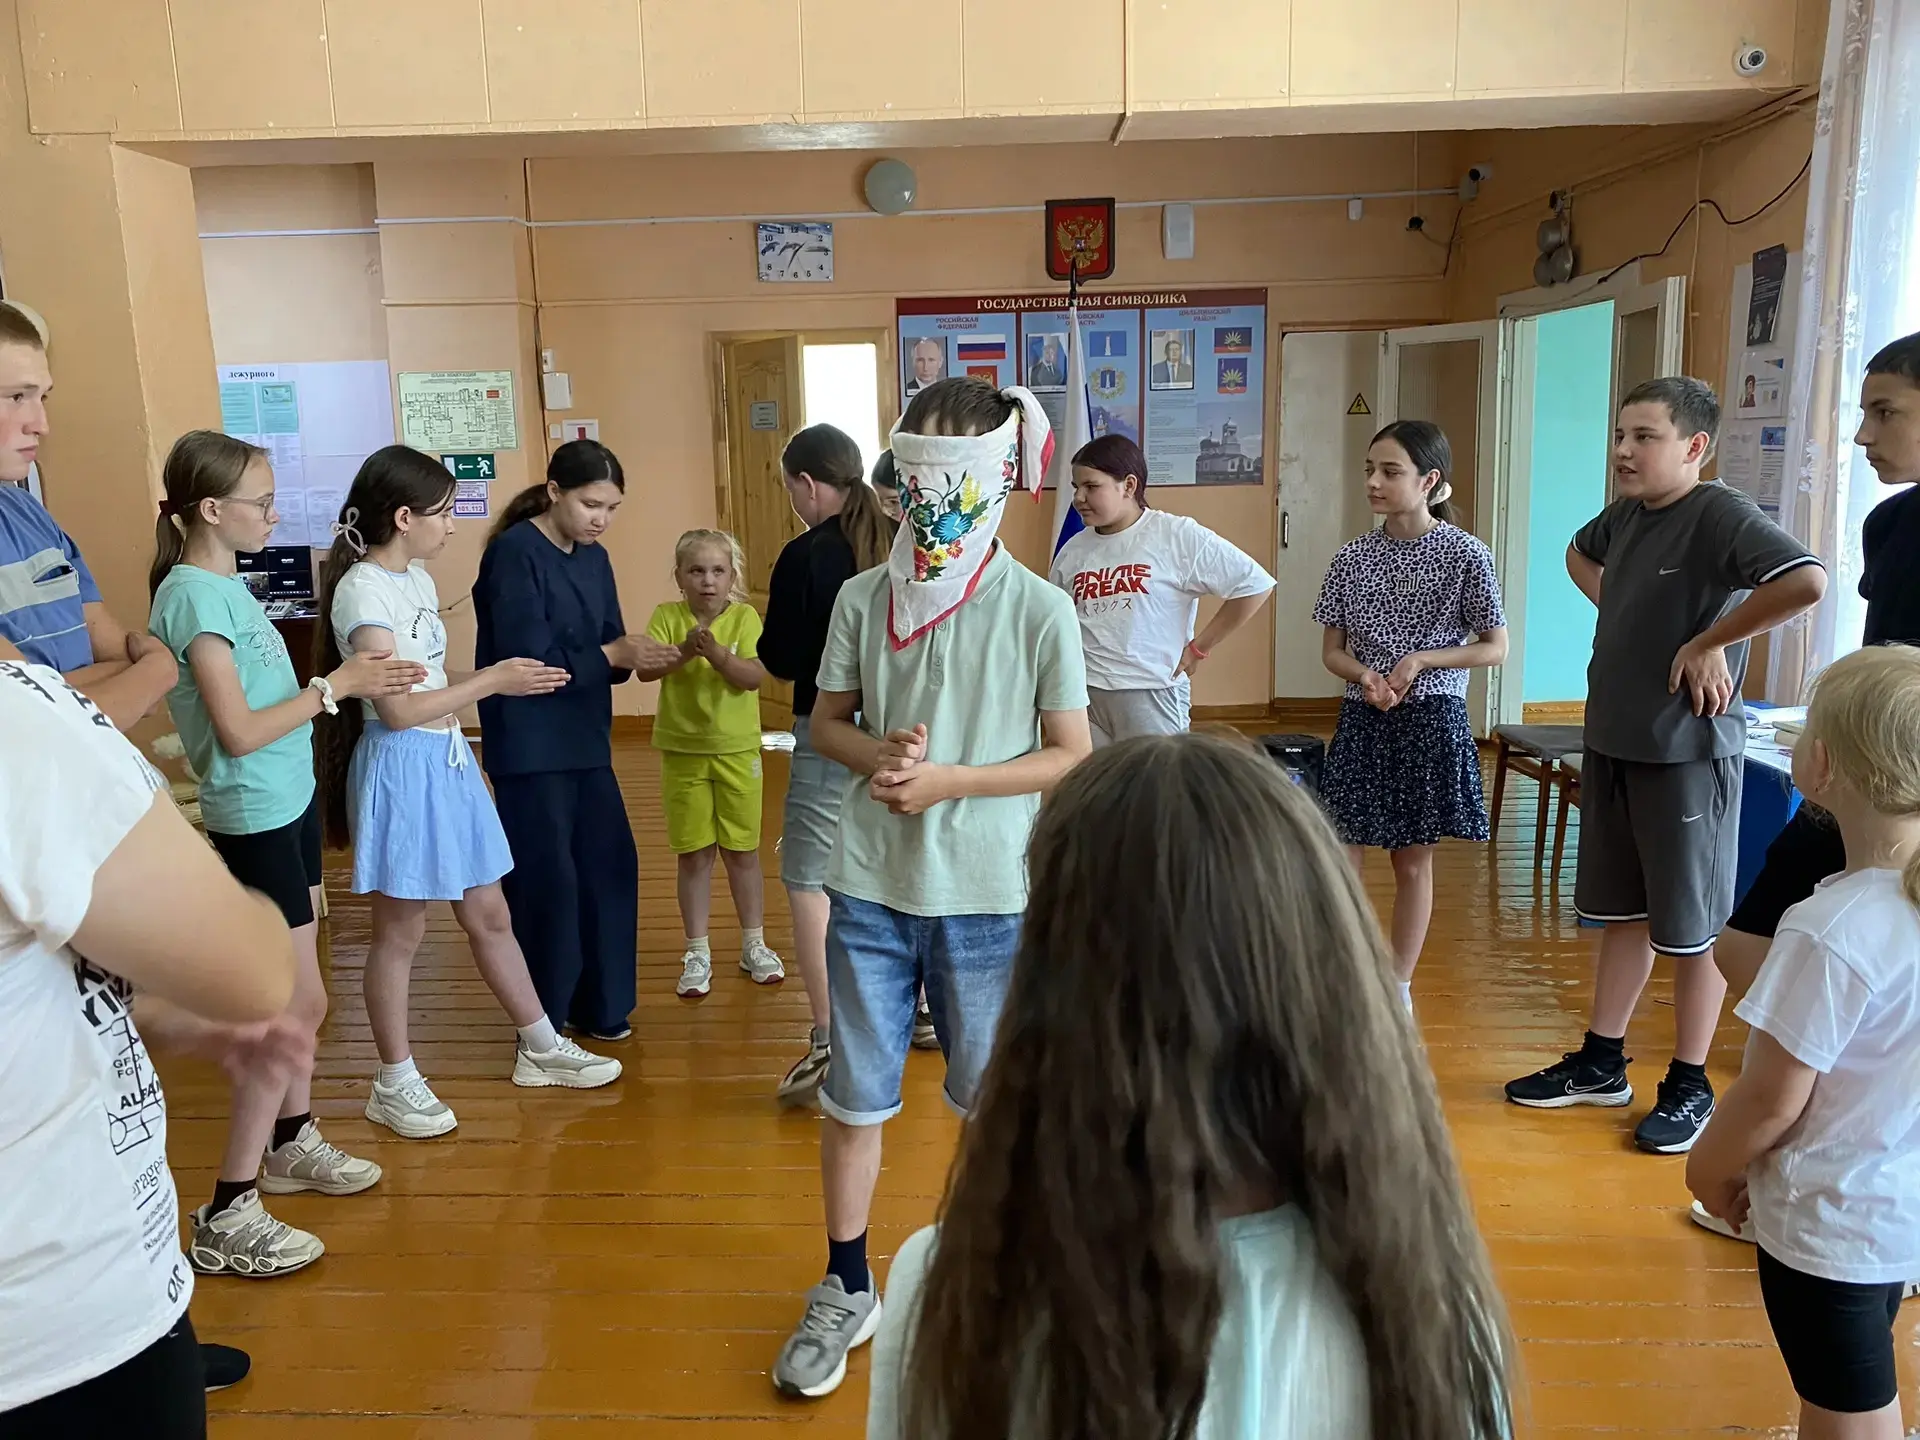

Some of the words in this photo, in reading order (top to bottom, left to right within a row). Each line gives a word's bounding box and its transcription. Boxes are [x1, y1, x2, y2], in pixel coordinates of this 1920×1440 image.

[790, 226, 799, 234] 12
[806, 270, 812, 278] 5
[1104, 293, 1187, 306] СИМВОЛИКА
[228, 371, 275, 380] дежурного
[1072, 563, 1152, 591] ANIME
[1389, 571, 1427, 590] Smile
[1073, 577, 1150, 606] FREAK
